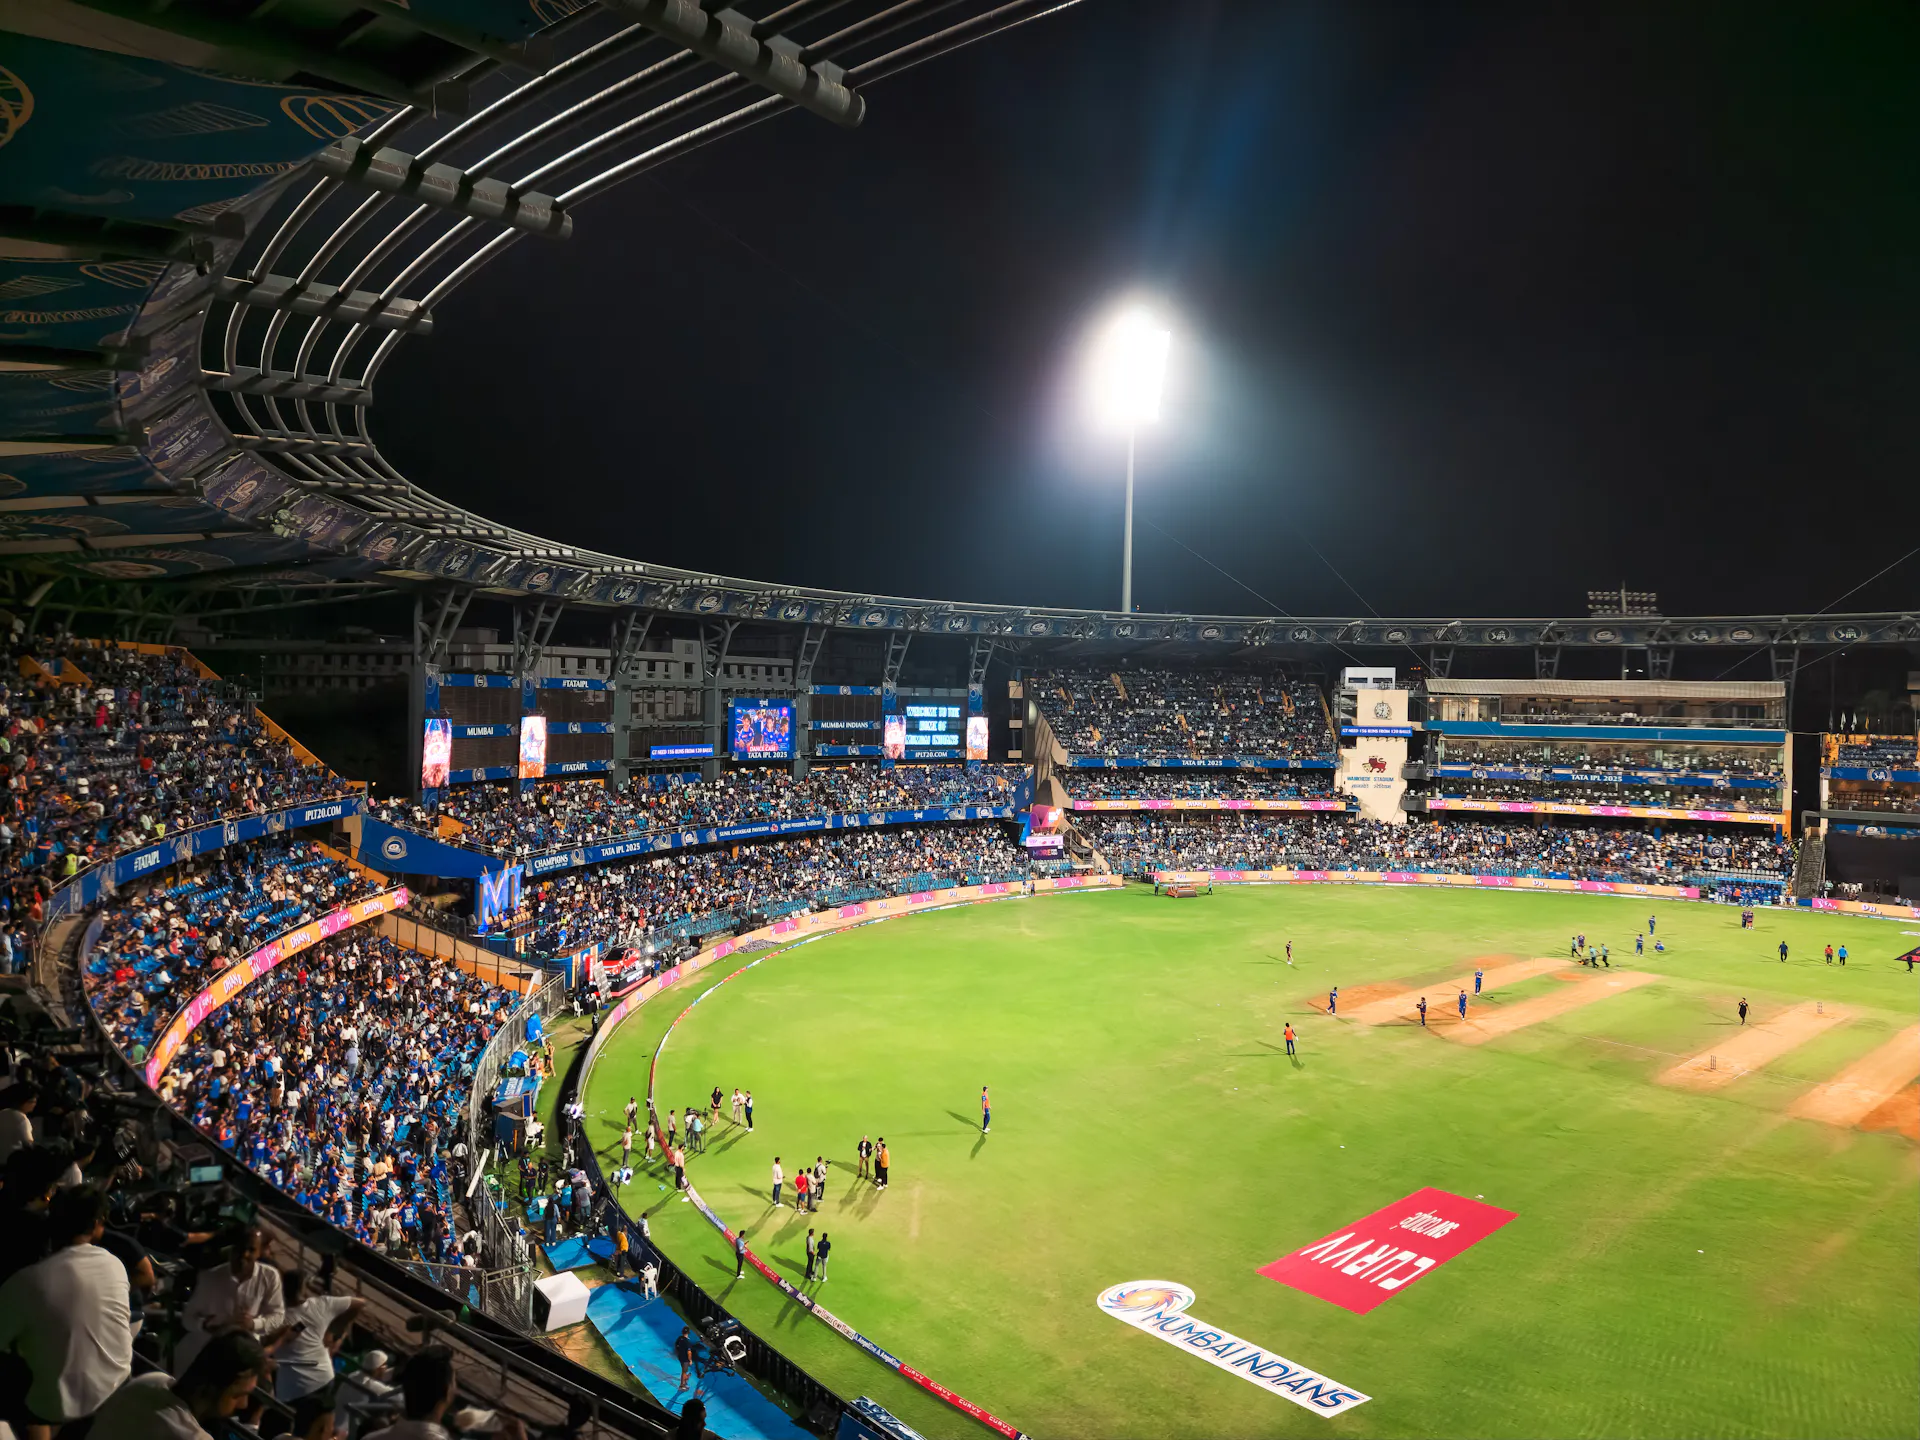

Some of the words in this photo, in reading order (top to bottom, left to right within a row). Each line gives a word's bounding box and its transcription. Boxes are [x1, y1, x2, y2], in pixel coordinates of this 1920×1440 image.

[562, 679, 589, 688] #TATAIPL
[466, 726, 494, 736] MUMBAI
[562, 763, 588, 771] #TATAIPL
[305, 805, 342, 821] IPLT20.COM
[601, 848, 615, 856] TATA
[626, 842, 640, 852] 2025
[134, 850, 160, 872] #TATAIPL
[534, 854, 568, 869] CHAMPIONS
[1300, 1232, 1436, 1290] CURVV
[1141, 1310, 1241, 1358] MUMBAI
[1232, 1346, 1360, 1408] INDIANS
[904, 1366, 924, 1380] CURVV
[930, 1382, 951, 1396] CURVV
[959, 1399, 981, 1414] CURVV
[989, 1416, 1012, 1431] CURVV
